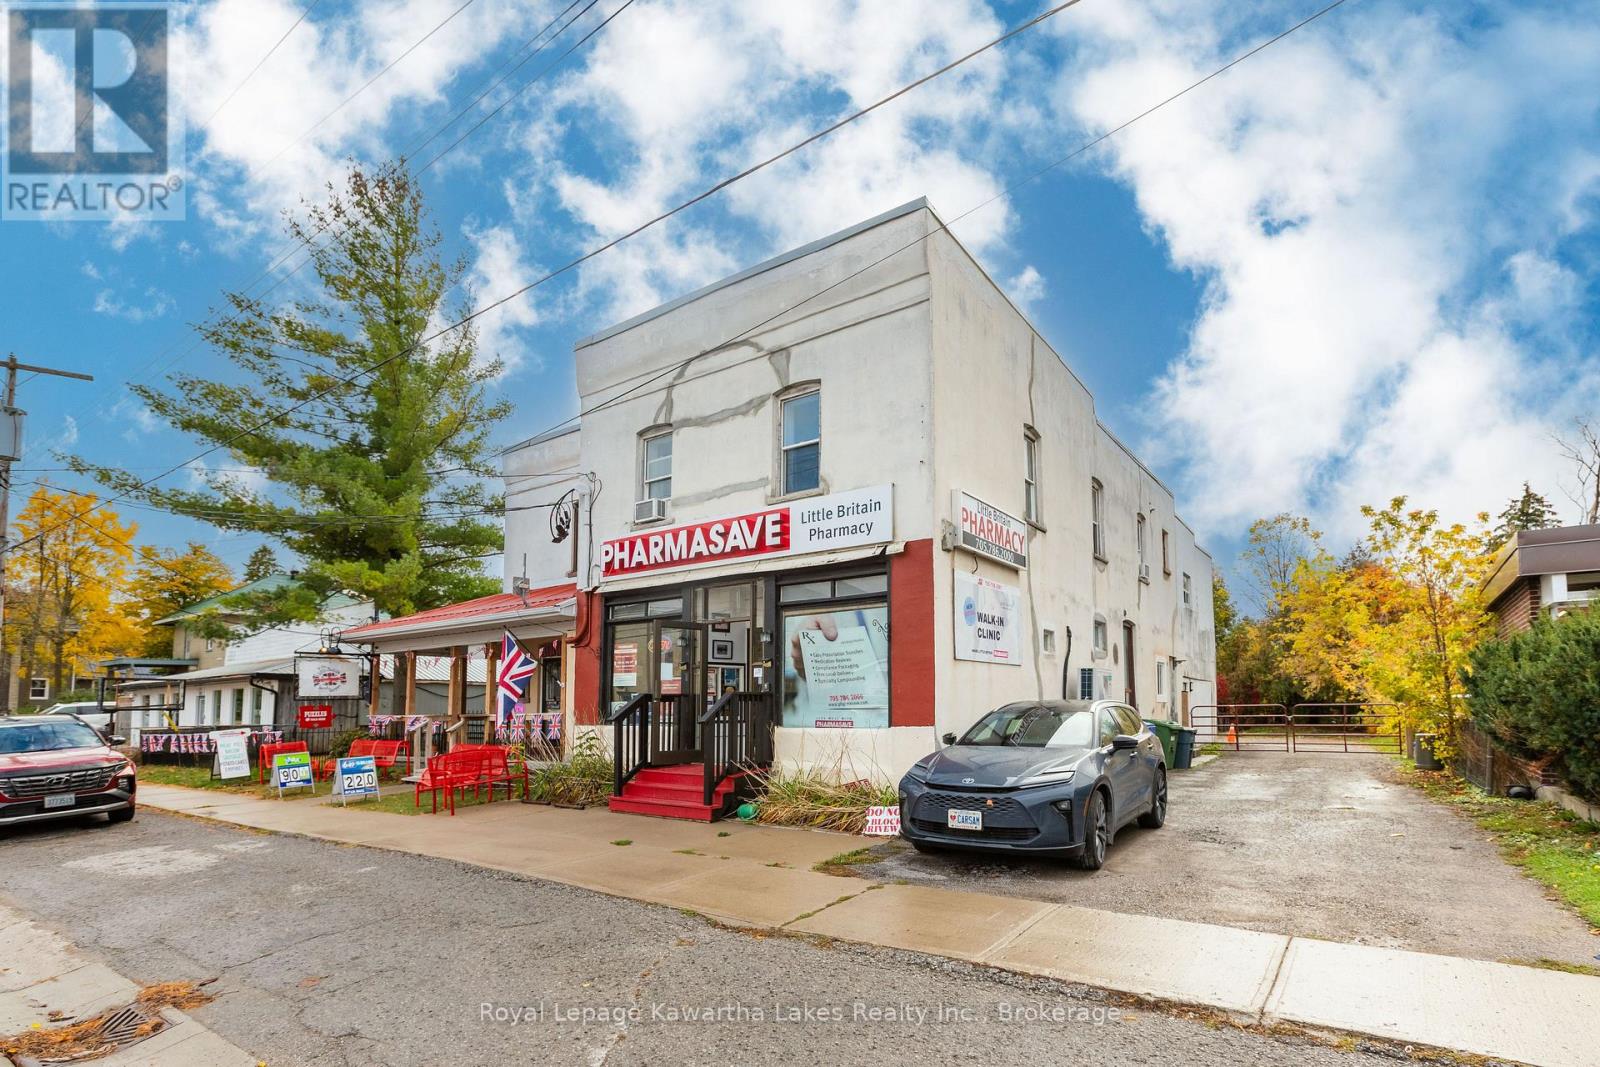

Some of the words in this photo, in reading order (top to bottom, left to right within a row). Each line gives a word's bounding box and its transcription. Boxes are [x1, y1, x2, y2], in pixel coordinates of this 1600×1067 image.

[801, 507, 833, 524] Little
[837, 499, 881, 518] Britain
[977, 502, 992, 519] Little
[992, 510, 1011, 528] Britain
[809, 521, 874, 541] Pharmacy
[962, 507, 1025, 554] PHARMACY
[600, 513, 781, 571] PHARMASAVE
[976, 611, 1005, 626] WALK-IN
[977, 627, 1001, 641] CLINIC
[887, 808, 900, 816] NO
